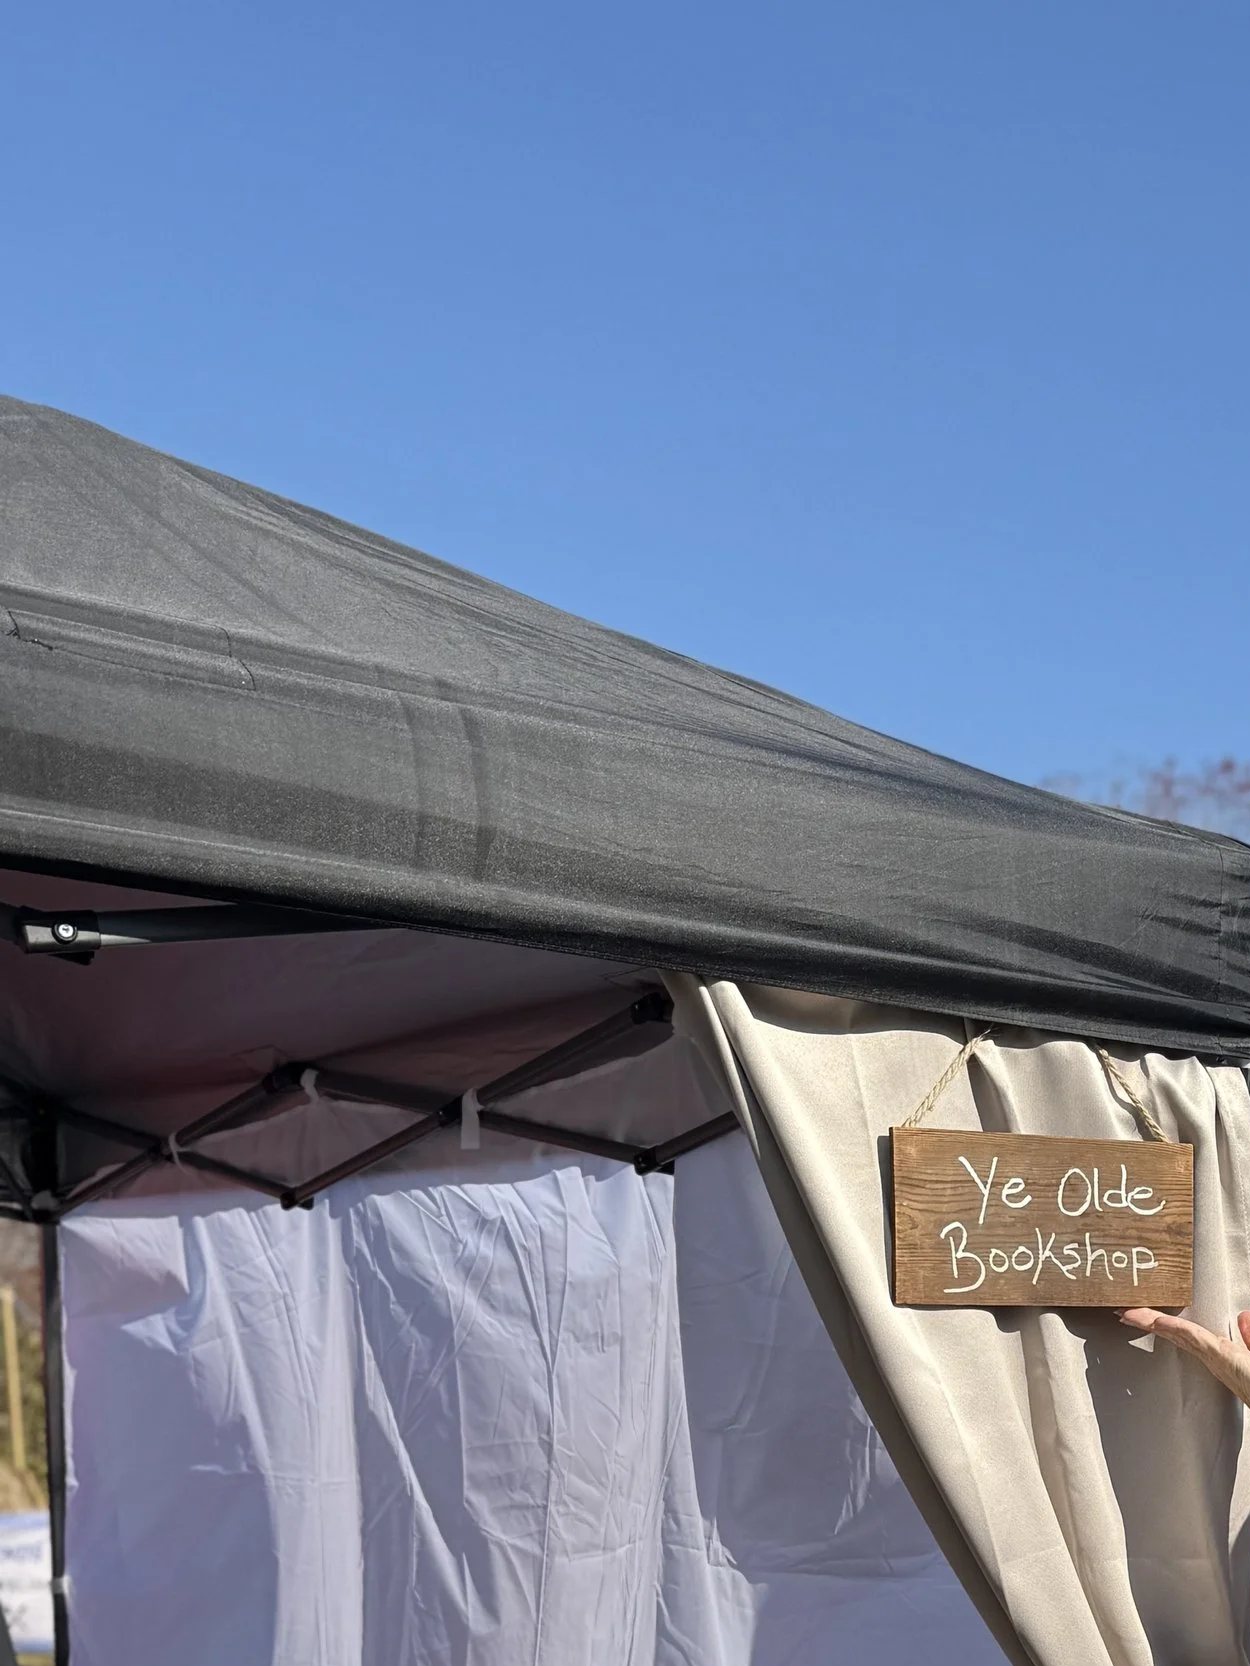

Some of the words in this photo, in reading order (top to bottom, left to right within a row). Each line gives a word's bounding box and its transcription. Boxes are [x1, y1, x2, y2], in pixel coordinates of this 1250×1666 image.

[958, 1155, 1033, 1225] Ye
[1057, 1163, 1167, 1217] Olde
[939, 1221, 1160, 1294] Bookshop
